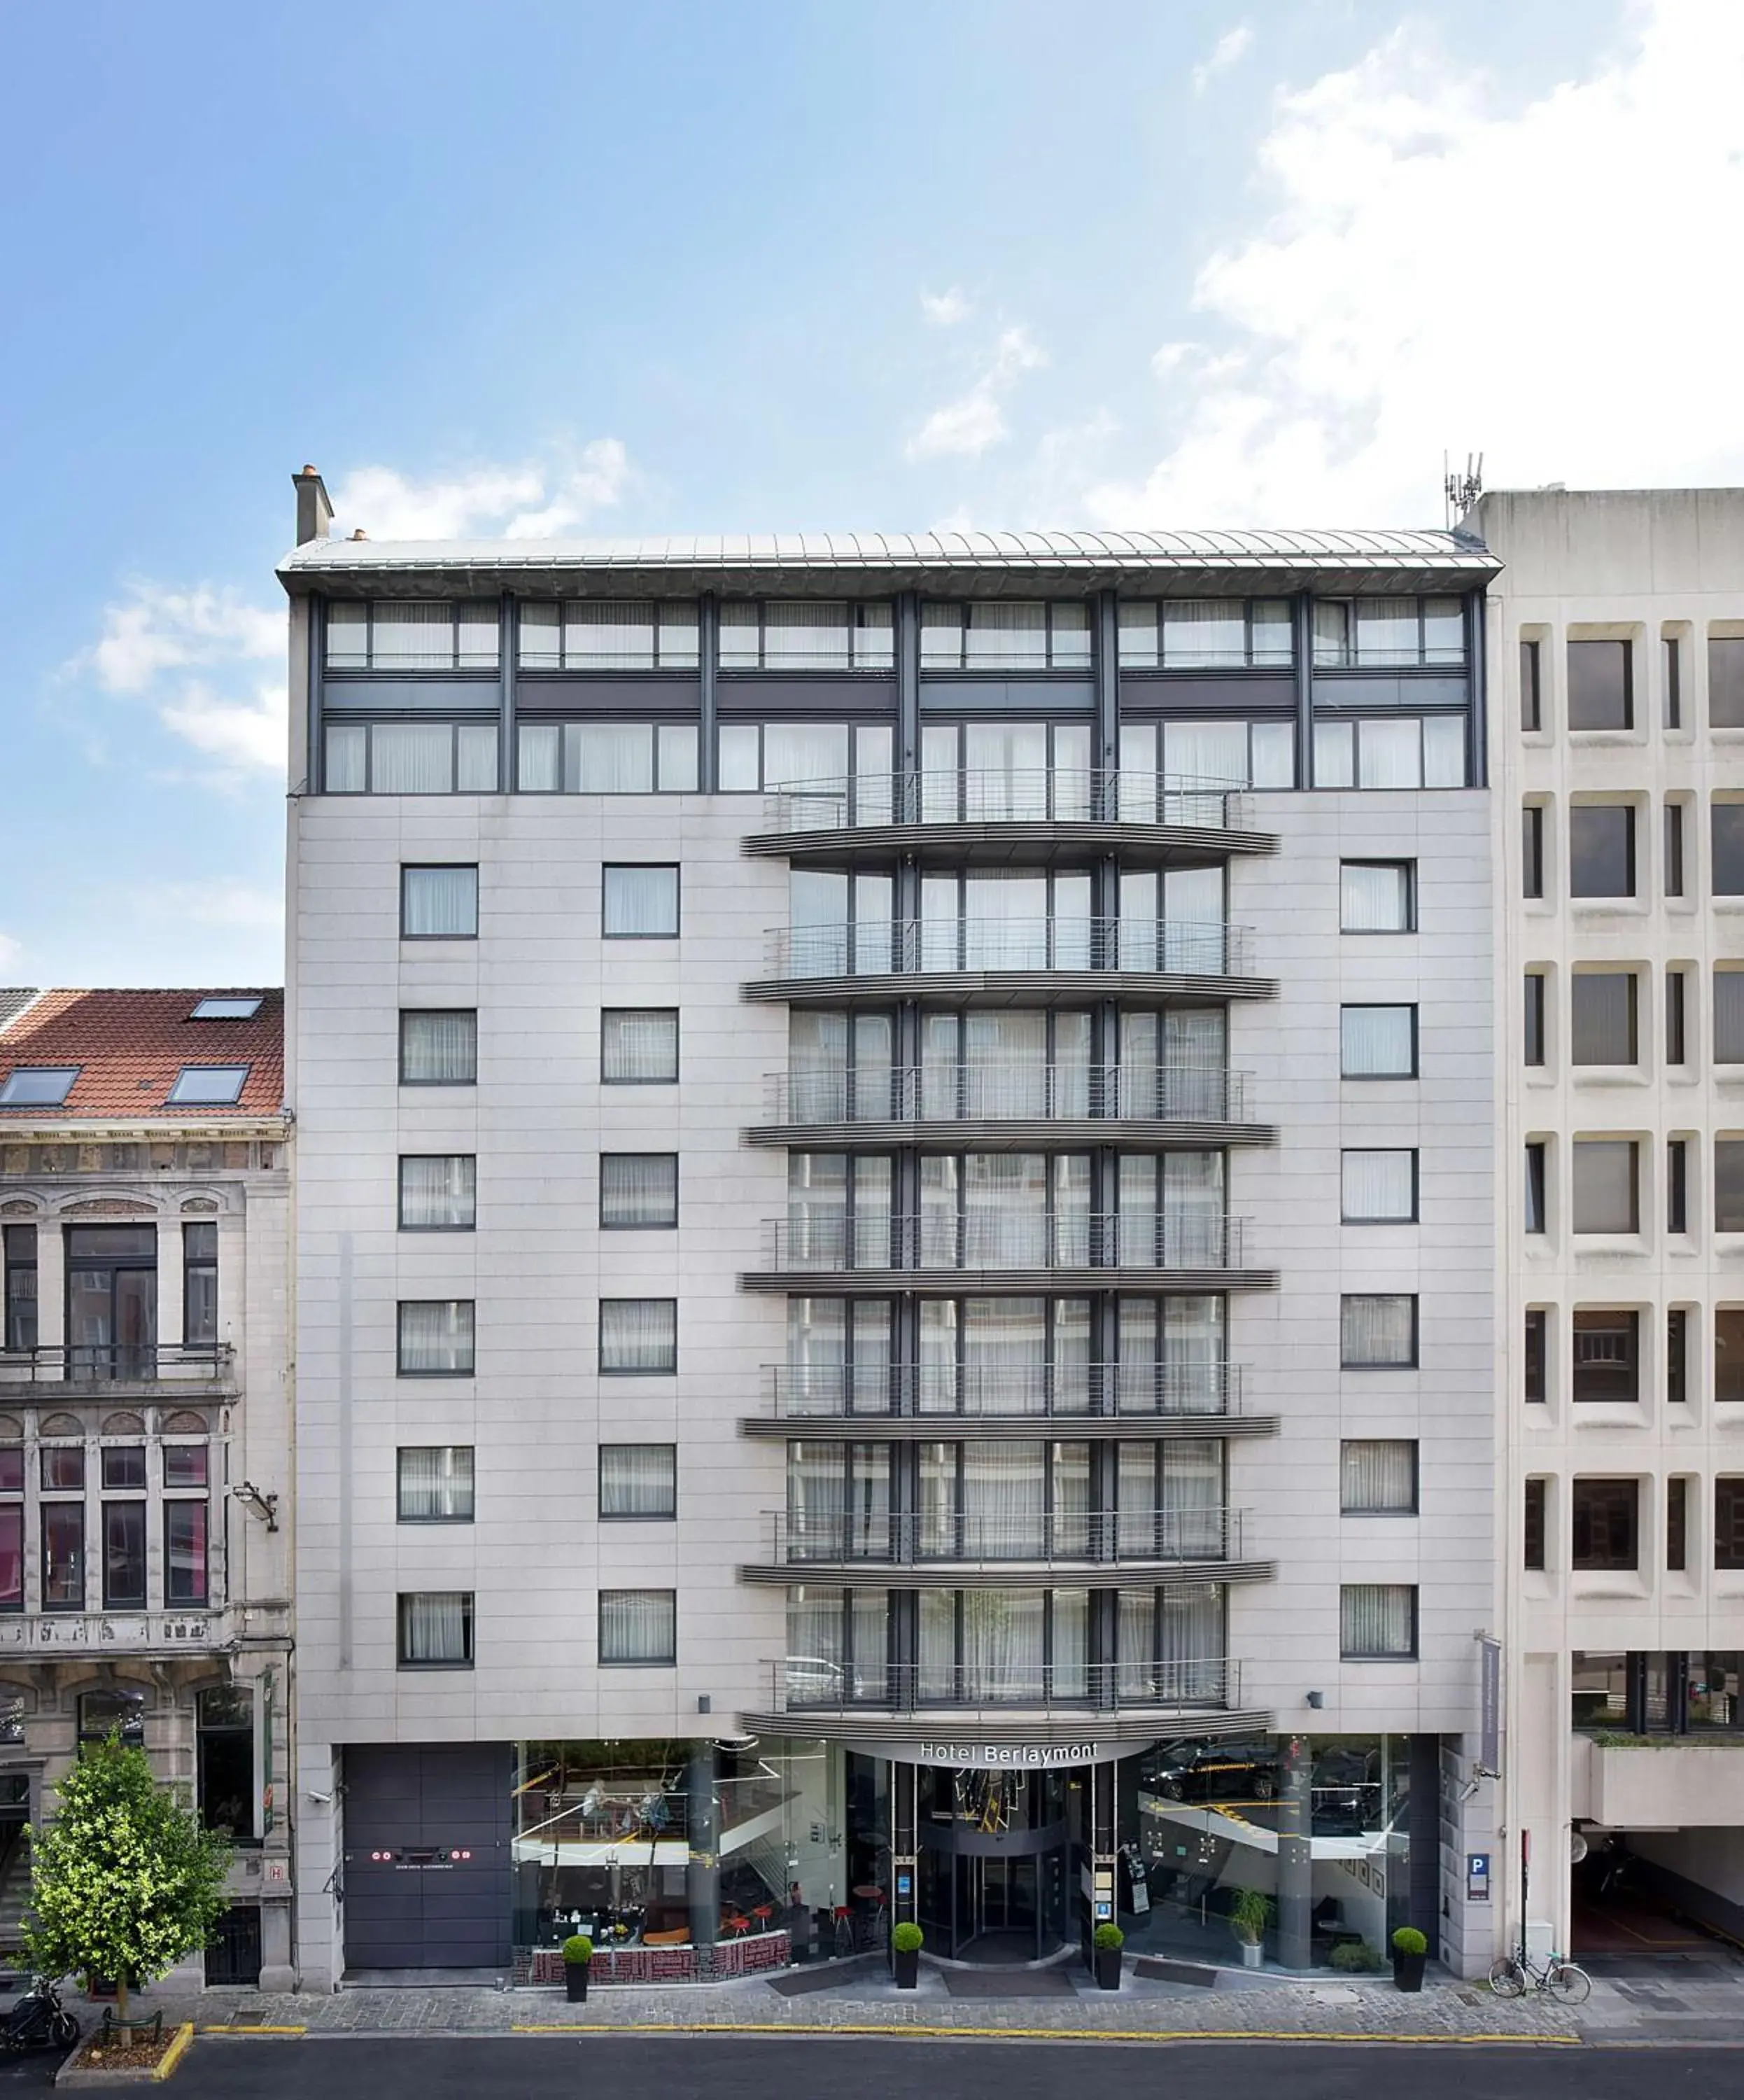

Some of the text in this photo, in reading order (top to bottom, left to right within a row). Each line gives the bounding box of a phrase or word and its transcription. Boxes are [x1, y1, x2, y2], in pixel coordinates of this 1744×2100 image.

[920, 1742, 1098, 1767] Hotel Berlaymont
[1472, 1858, 1483, 1872] P
